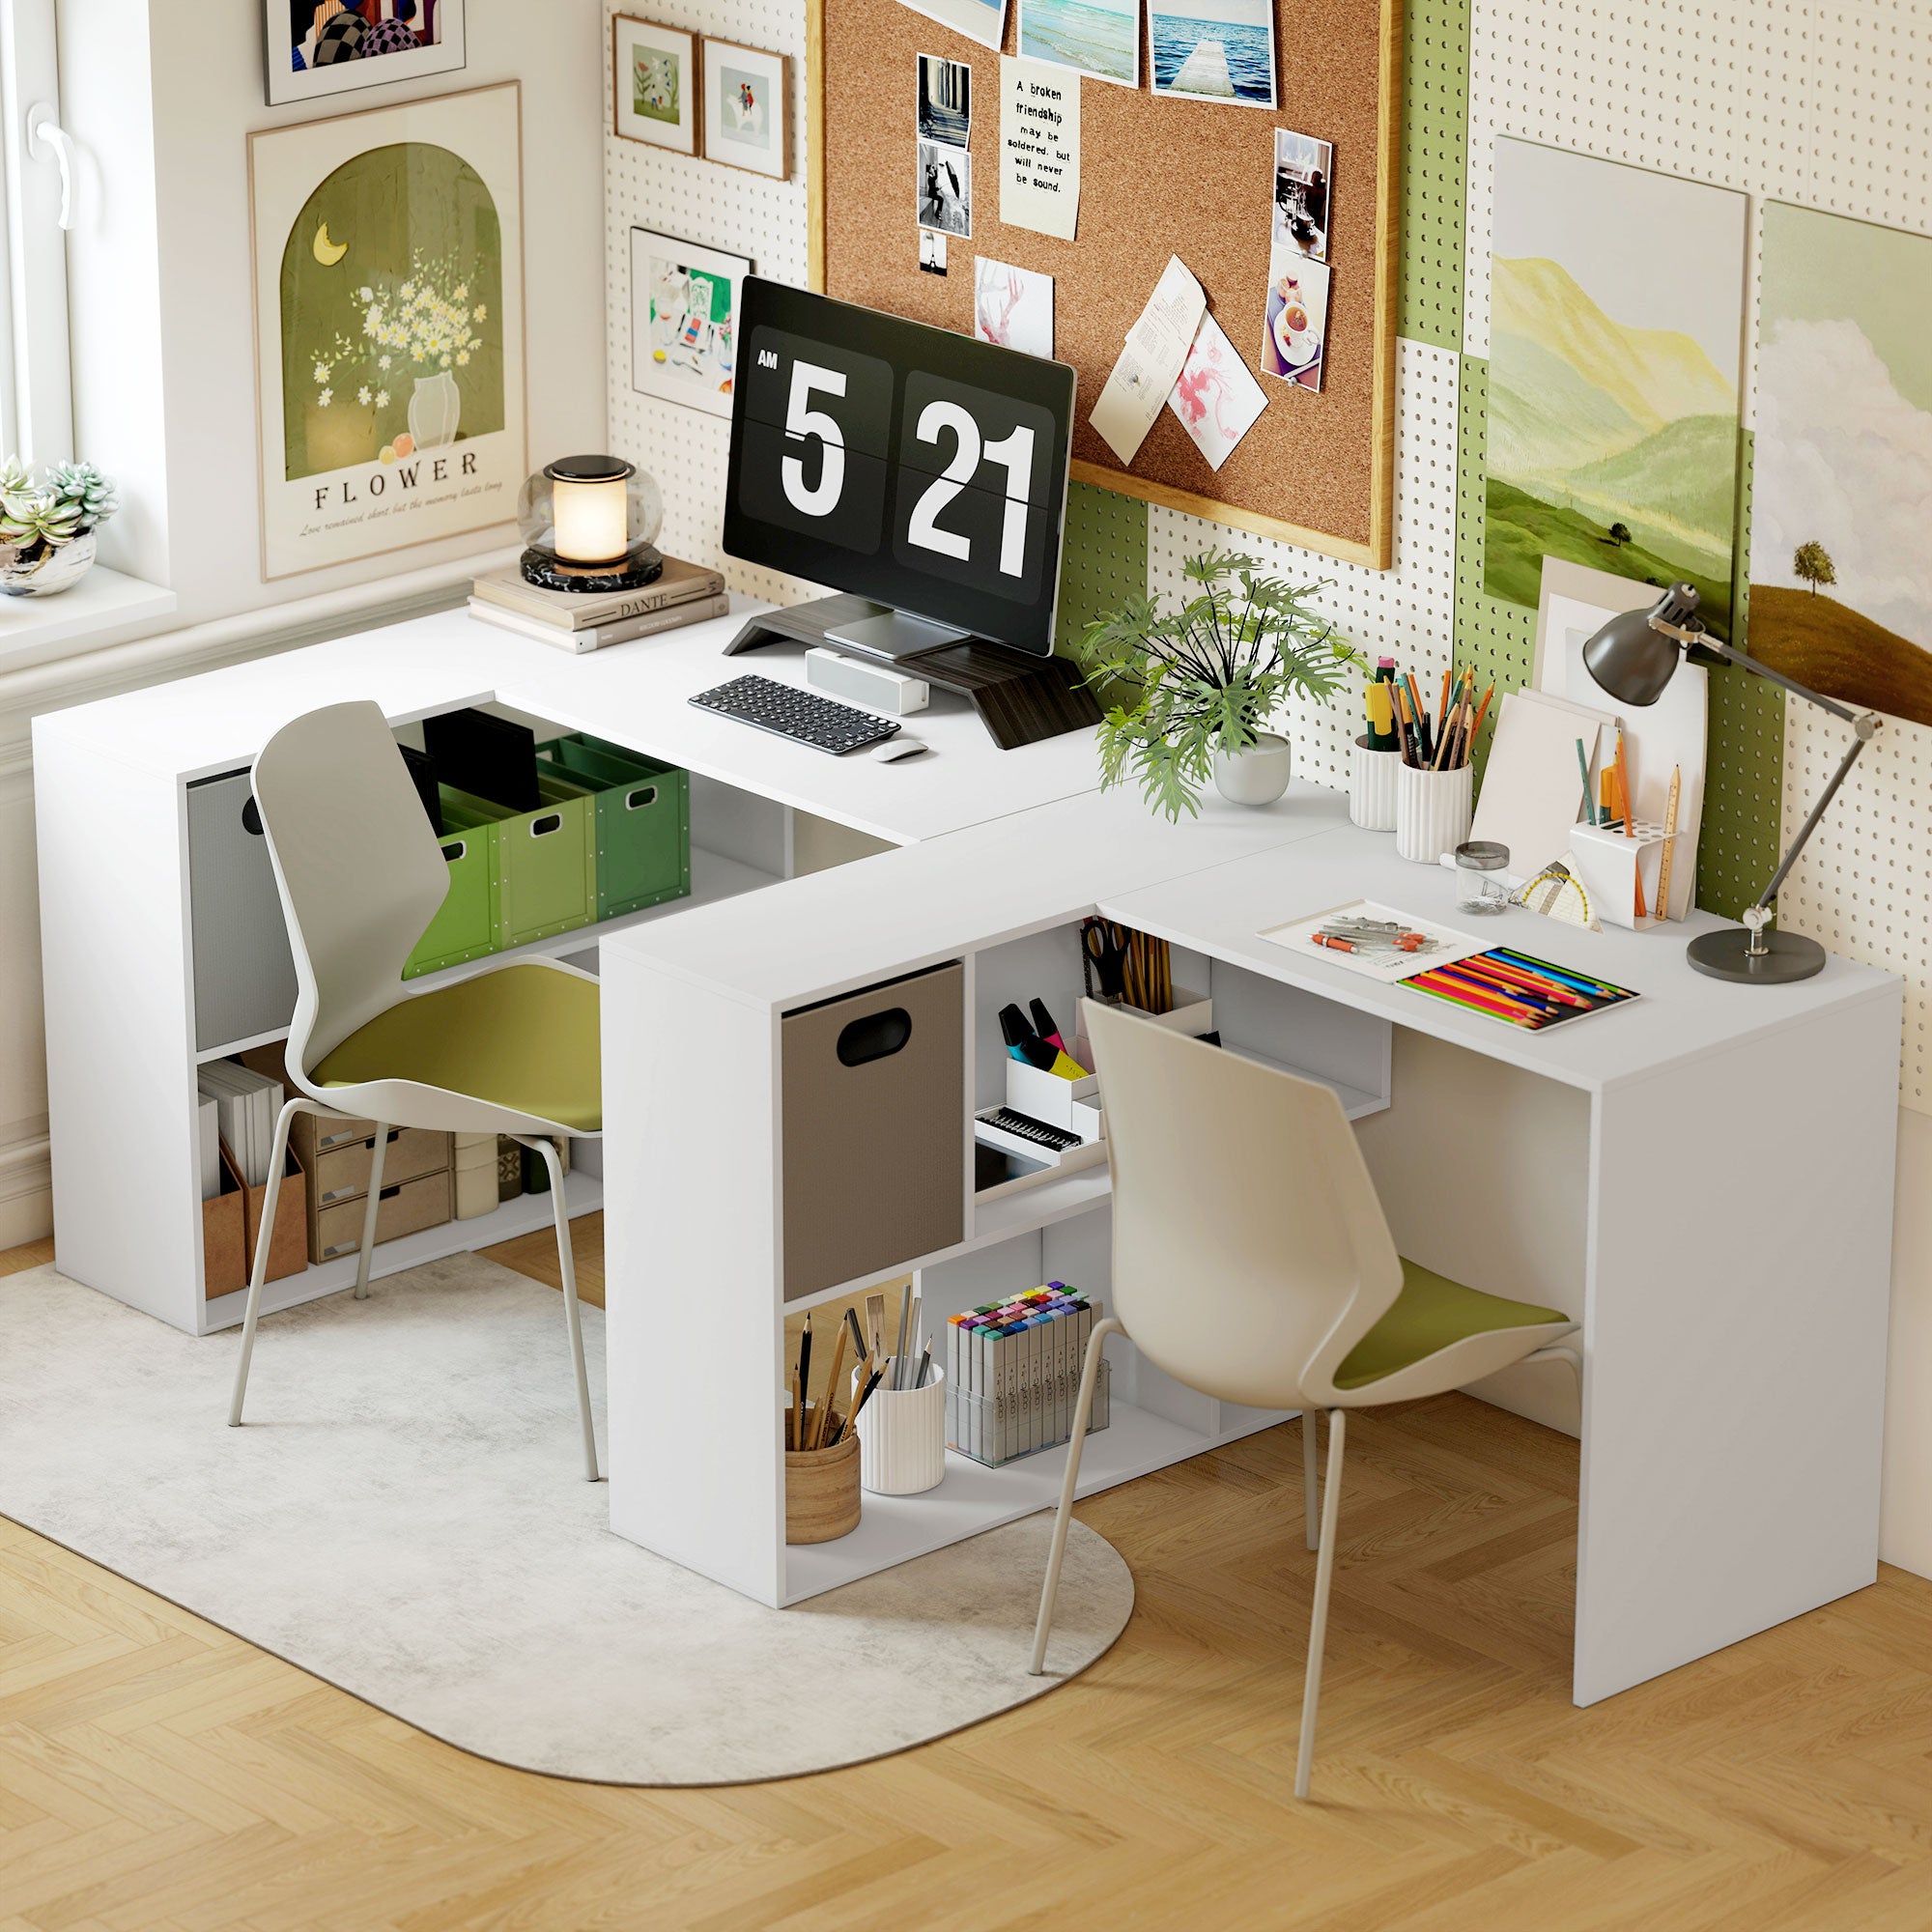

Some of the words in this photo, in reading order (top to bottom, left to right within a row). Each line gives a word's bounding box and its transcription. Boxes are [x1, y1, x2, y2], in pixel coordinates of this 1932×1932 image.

[1016, 80, 1024, 92] A
[1030, 83, 1062, 100] broken
[1015, 102, 1063, 127] friendship
[1020, 127, 1041, 139] may
[1047, 132, 1059, 142] be
[1056, 151, 1070, 161] but
[1014, 157, 1032, 168] will
[1037, 162, 1063, 176] never
[1016, 173, 1027, 185] be
[1033, 178, 1061, 192] sound.
[757, 349, 778, 370] AM
[781, 359, 847, 517] 5
[907, 400, 1036, 579] 21
[315, 452, 477, 510] FLOWER
[619, 593, 668, 618] DANTE
